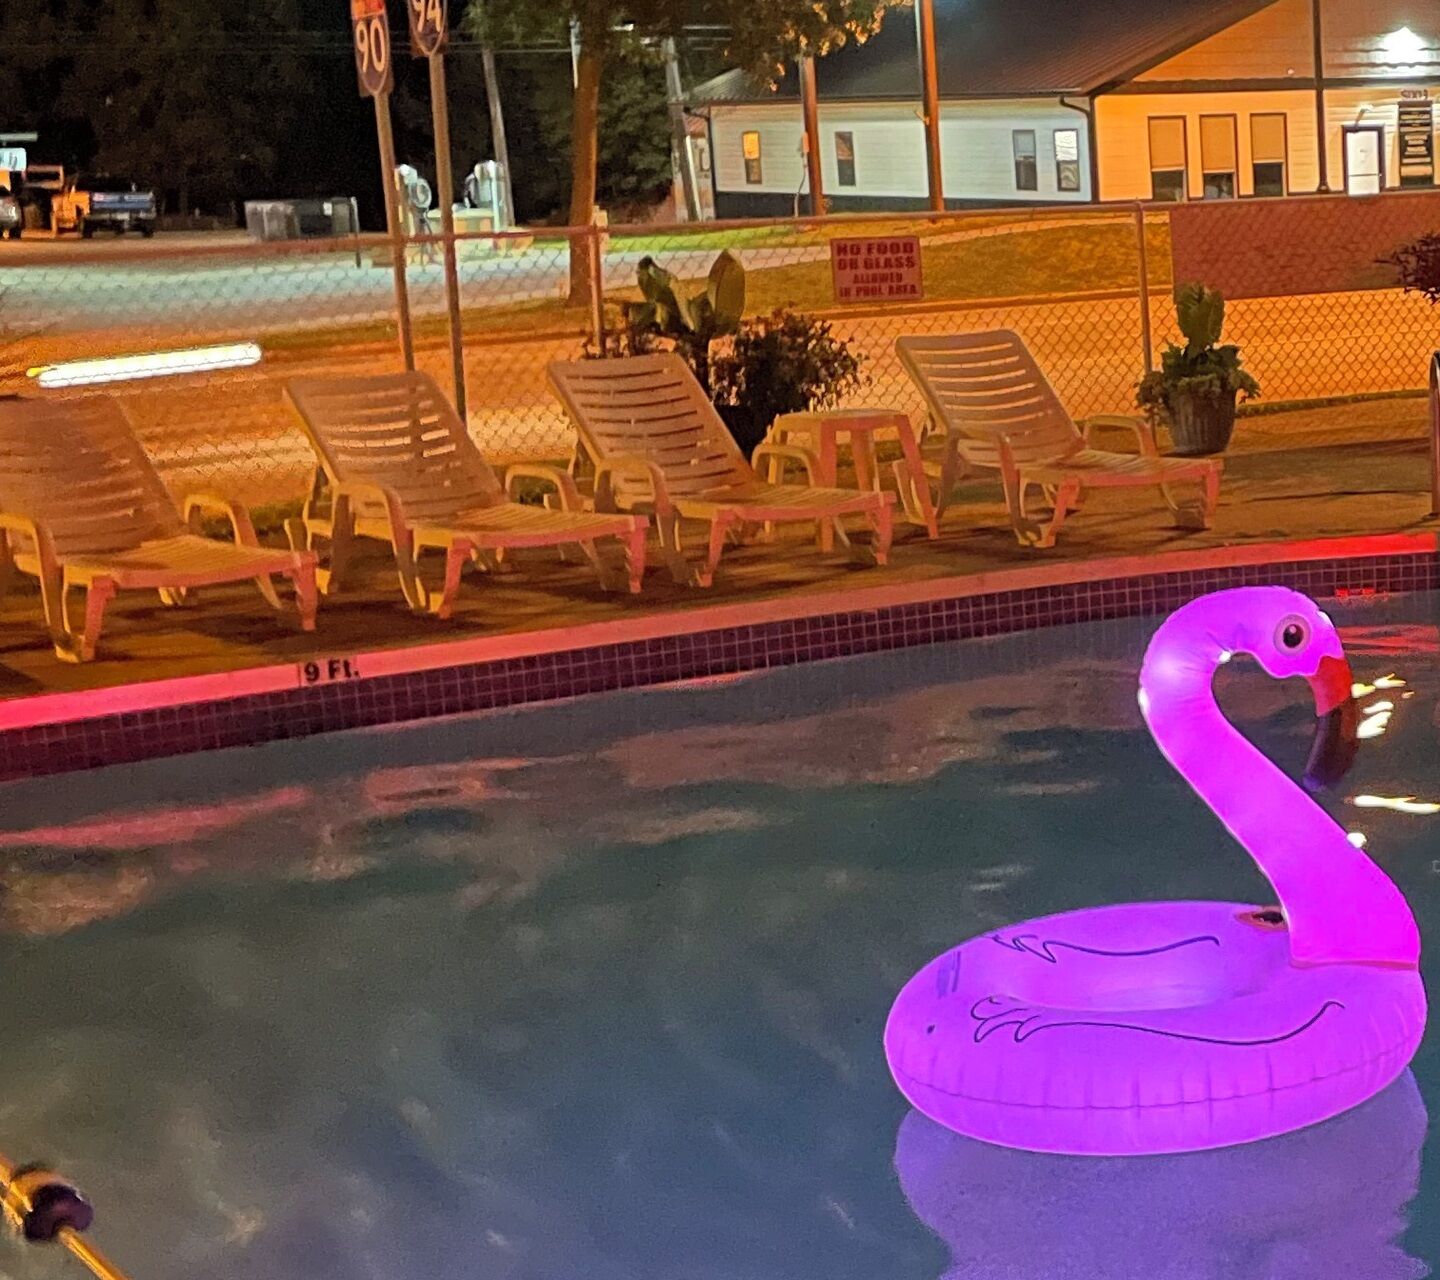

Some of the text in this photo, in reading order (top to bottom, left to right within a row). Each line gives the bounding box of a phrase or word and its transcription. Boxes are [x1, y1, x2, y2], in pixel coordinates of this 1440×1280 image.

[355, 17, 386, 73] 90
[836, 242, 914, 256] NO FOOD
[837, 256, 916, 270] OR GLASS
[852, 272, 903, 284] ALLOWED
[855, 285, 883, 297] POOL
[304, 661, 320, 681] 9
